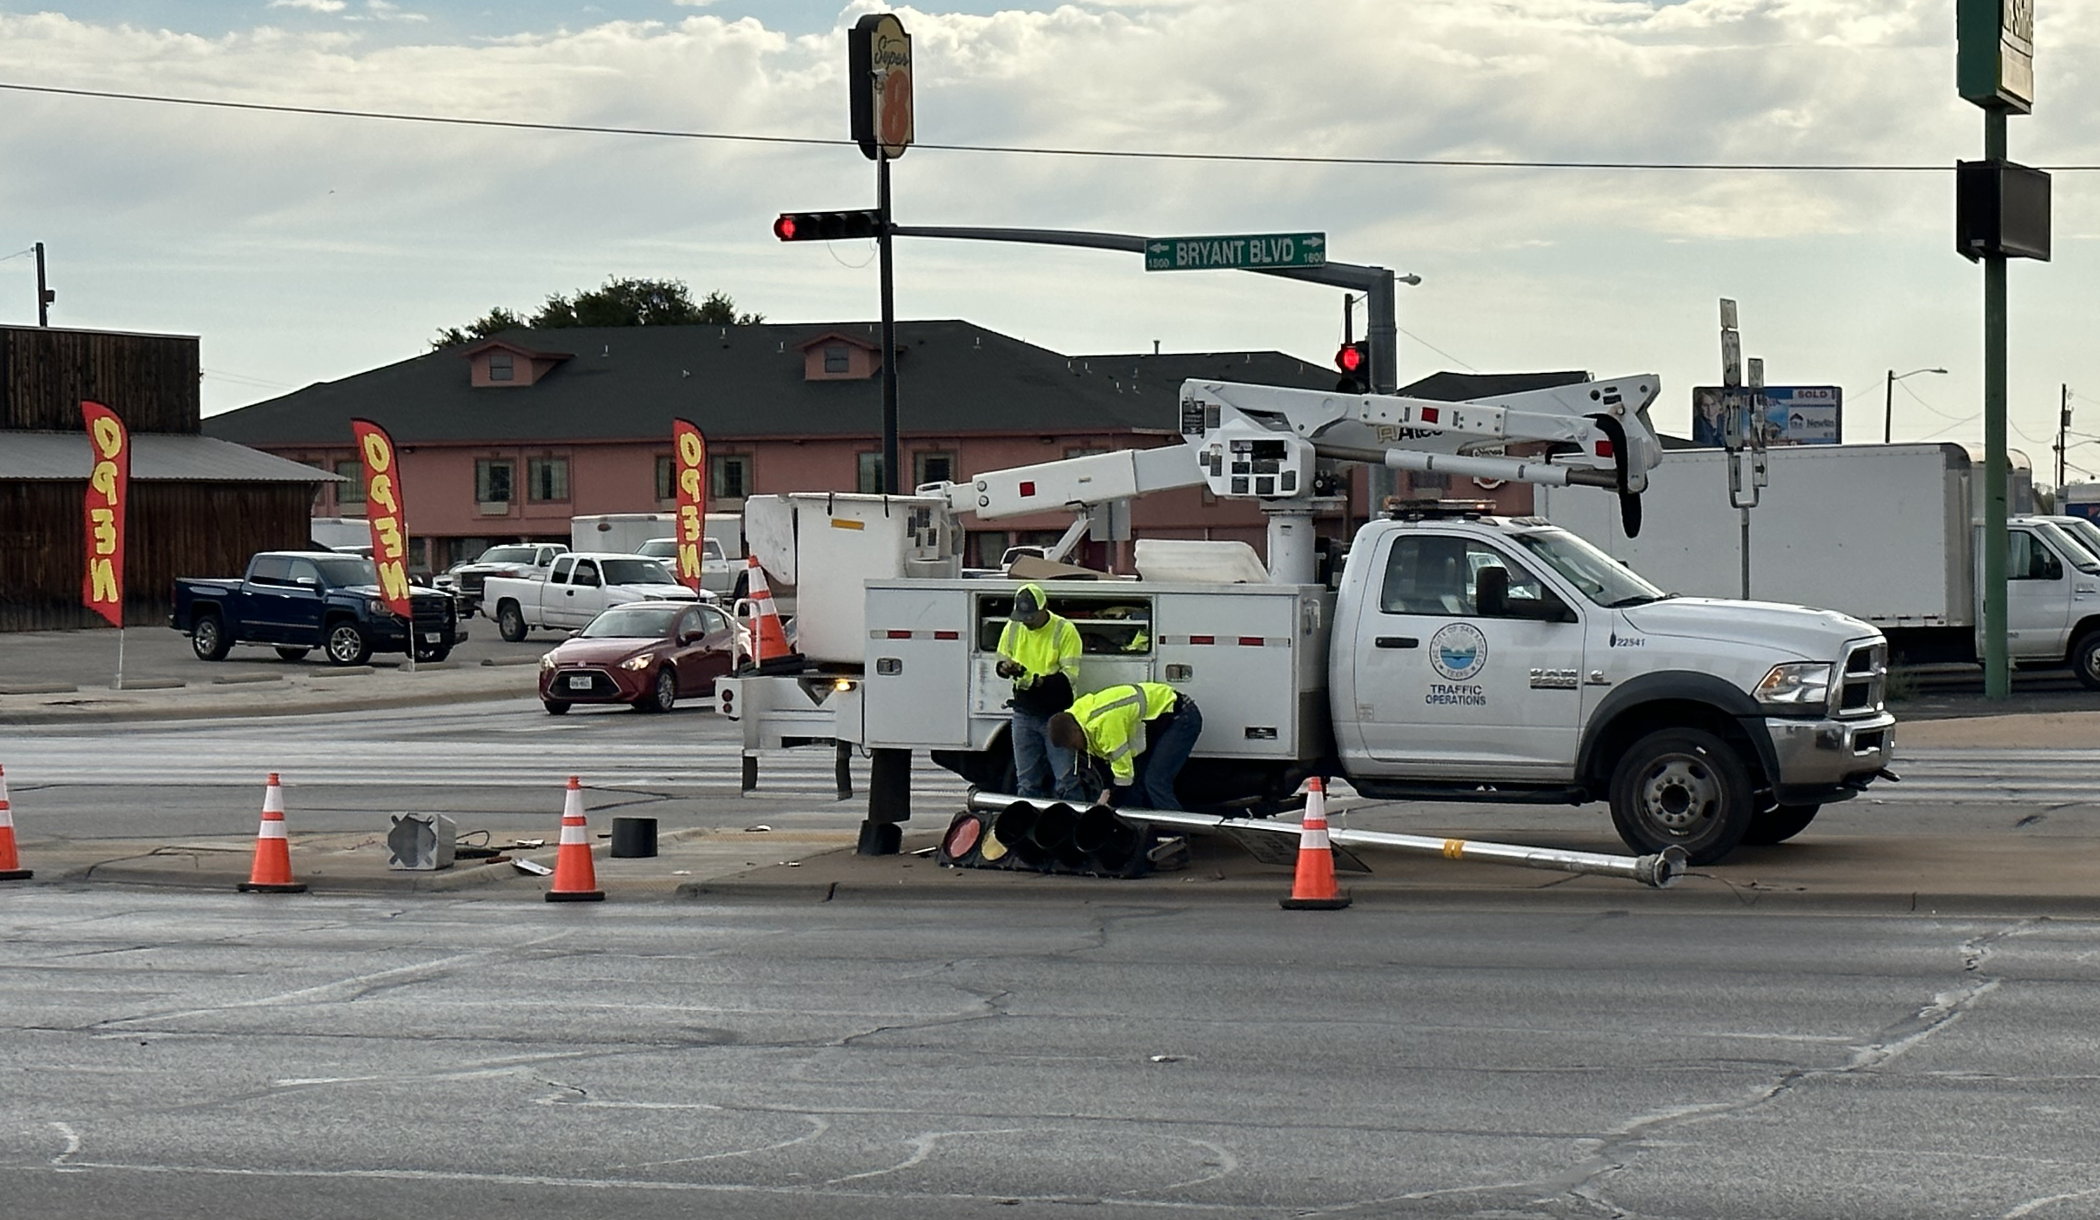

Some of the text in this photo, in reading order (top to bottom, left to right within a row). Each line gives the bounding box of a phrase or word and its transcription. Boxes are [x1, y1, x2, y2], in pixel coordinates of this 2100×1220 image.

[874, 35, 909, 71] Super
[881, 70, 909, 144] 8
[1176, 238, 1294, 266] BRYANT BLVD
[1797, 390, 1829, 398] SOLD
[1430, 684, 1483, 695] TRAFFIC
[1425, 694, 1487, 706] OPERATIONS
